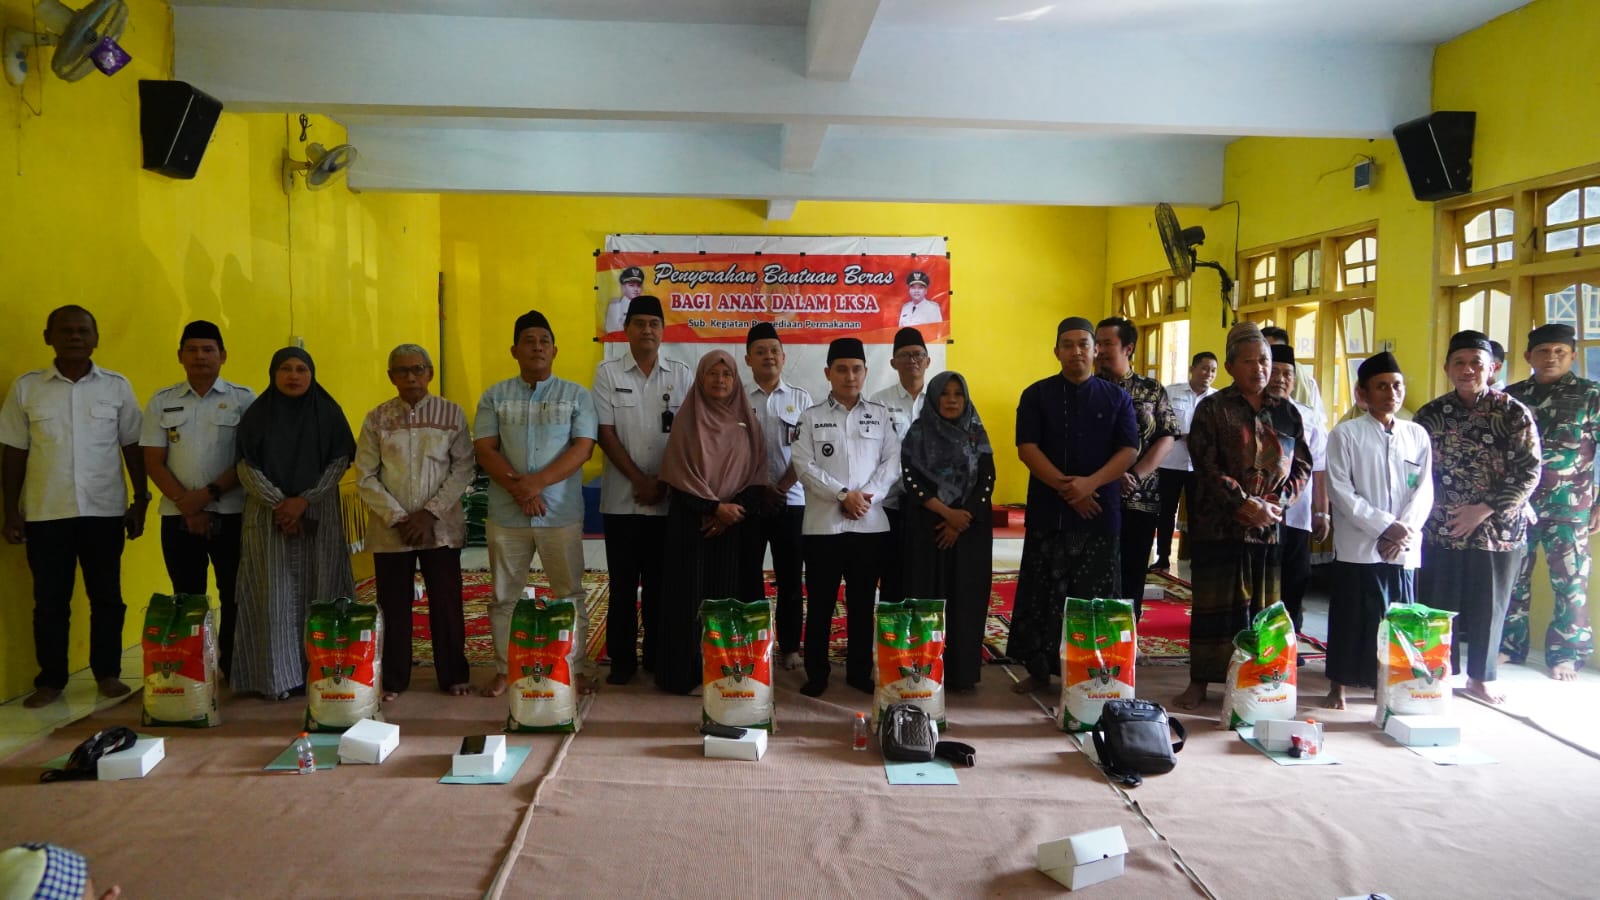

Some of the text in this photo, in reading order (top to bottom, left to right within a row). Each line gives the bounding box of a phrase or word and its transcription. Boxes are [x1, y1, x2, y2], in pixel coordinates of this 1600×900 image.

[654, 263, 894, 288] Penyerahan Bantuan Beras
[671, 294, 878, 311] BAGI ANAK DALAM LKSA
[688, 320, 706, 329] Sub.
[711, 320, 748, 330] Kegiatan
[805, 320, 861, 329] Permakanan
